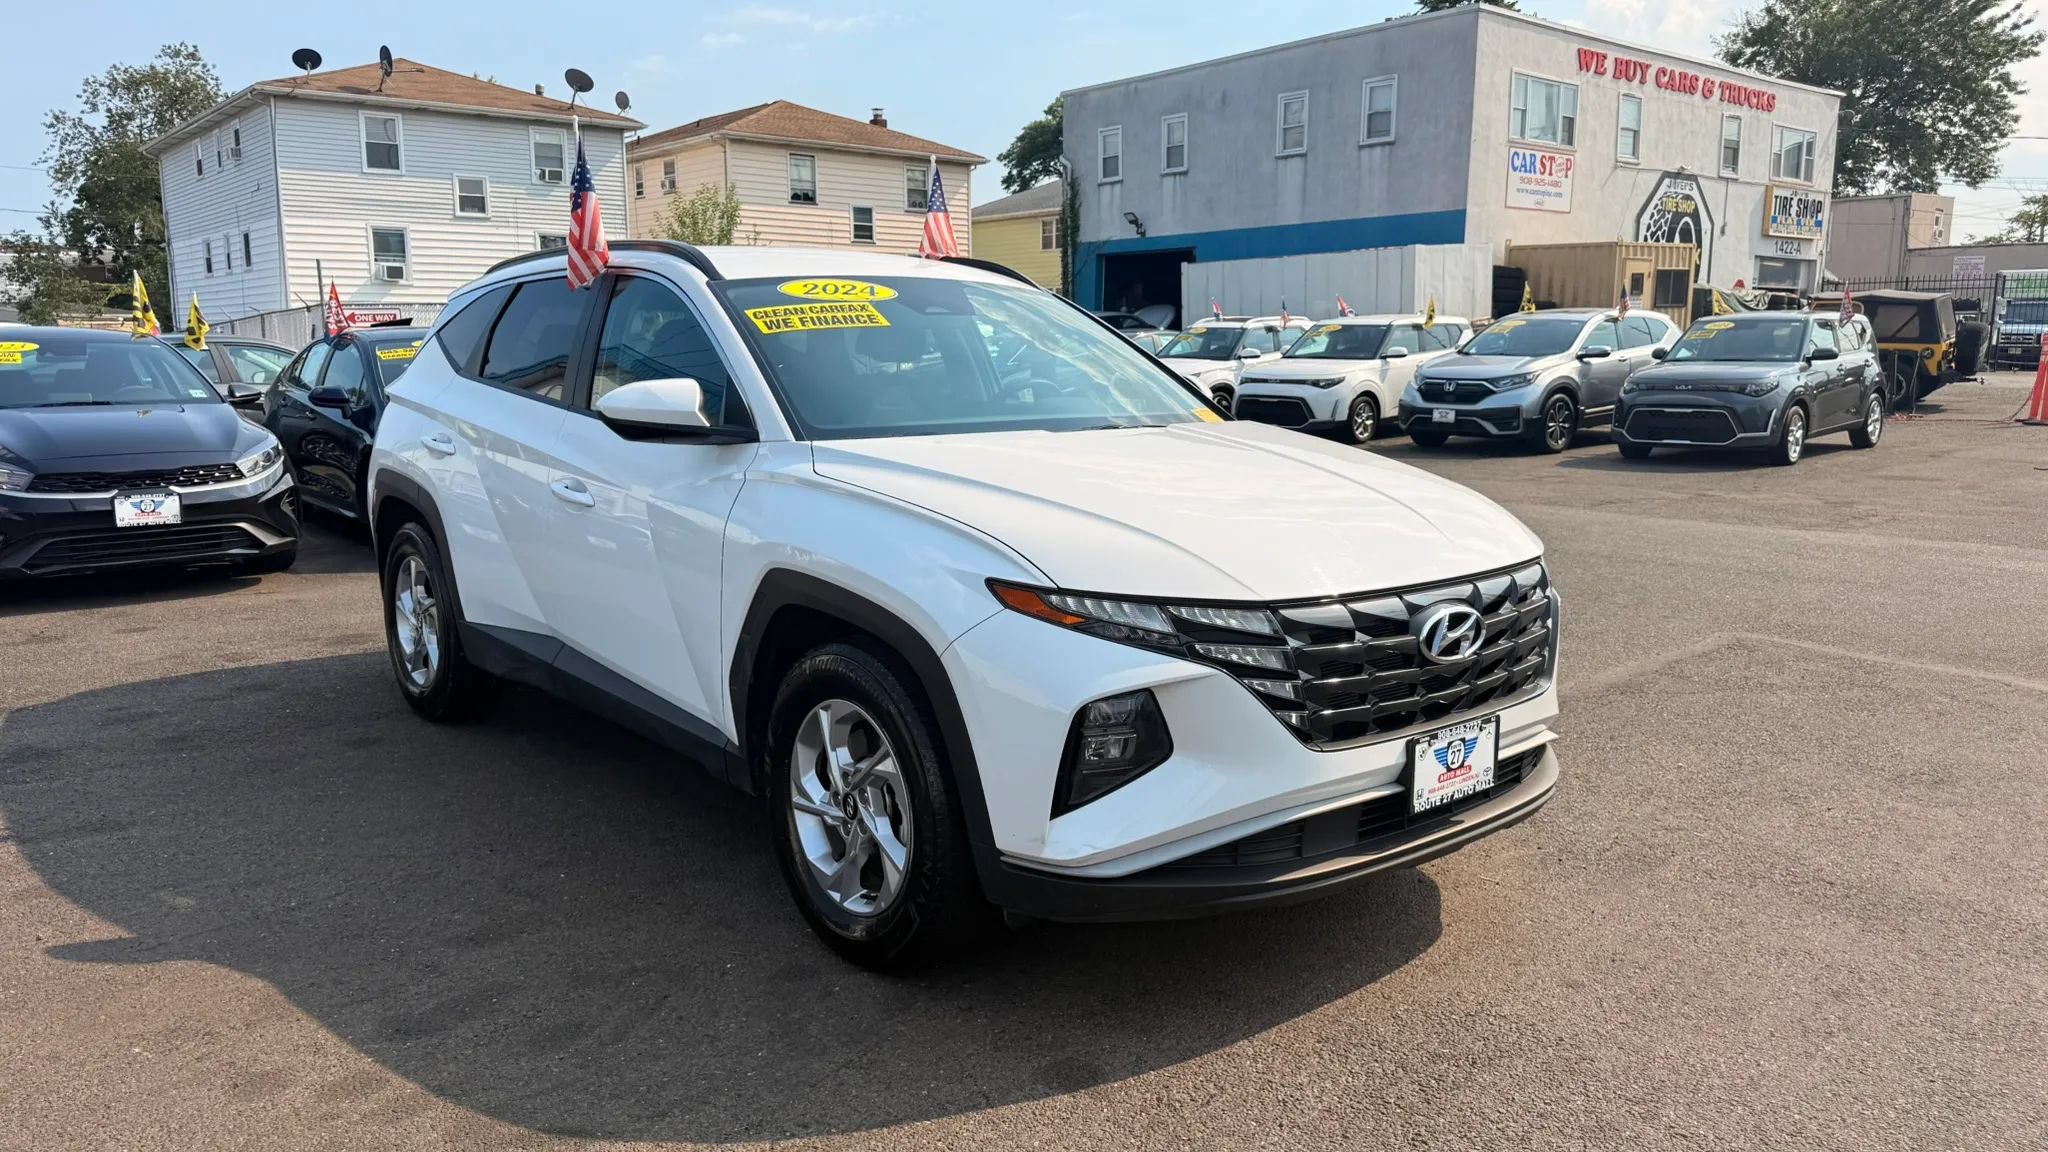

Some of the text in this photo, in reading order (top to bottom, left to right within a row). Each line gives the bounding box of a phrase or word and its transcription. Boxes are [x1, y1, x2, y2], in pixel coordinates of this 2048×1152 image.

[1577, 47, 1777, 112] WE BUY CARS & TRUCKS
[1511, 151, 1537, 174] CAR
[1663, 197, 1696, 215] TIRE SHOP
[1773, 195, 1823, 220] TIRE SHOP
[1774, 240, 1802, 255] 1422-A
[803, 282, 879, 297] 2024
[375, 314, 395, 322] WAY
[752, 303, 870, 320] CLEAN CARFAX
[762, 314, 880, 331] WE FINANCE
[1450, 748, 1462, 766] 27
[1440, 765, 1471, 782] AUTO MALL
[1414, 777, 1496, 813] ROUTE 27 AUTO MALL
